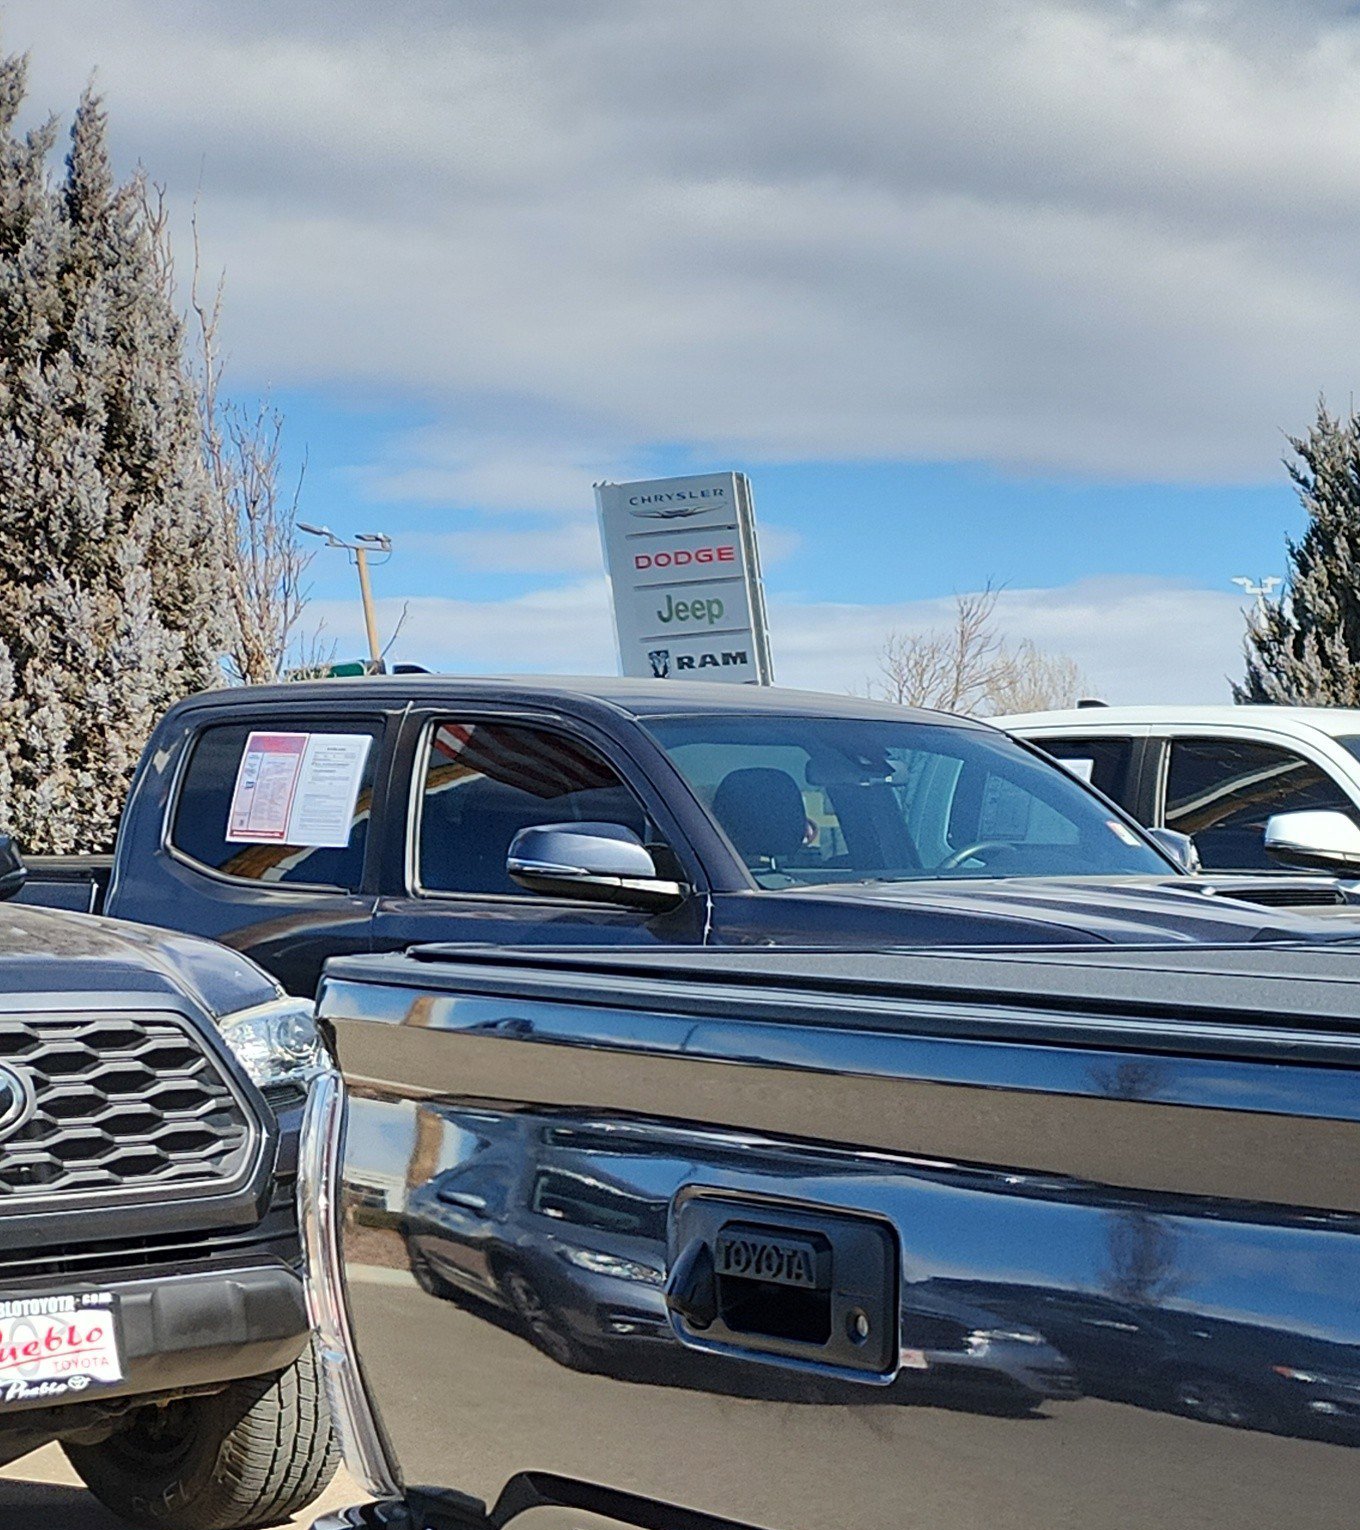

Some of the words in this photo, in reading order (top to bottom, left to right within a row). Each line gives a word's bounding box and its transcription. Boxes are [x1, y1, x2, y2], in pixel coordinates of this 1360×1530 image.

[629, 487, 725, 506] CHRYSLER
[634, 546, 735, 570] DODGE
[656, 594, 725, 625] Jeep
[675, 651, 749, 671] RAM
[722, 1240, 815, 1284] TOYOTA
[52, 1357, 109, 1374] TOYOTA
